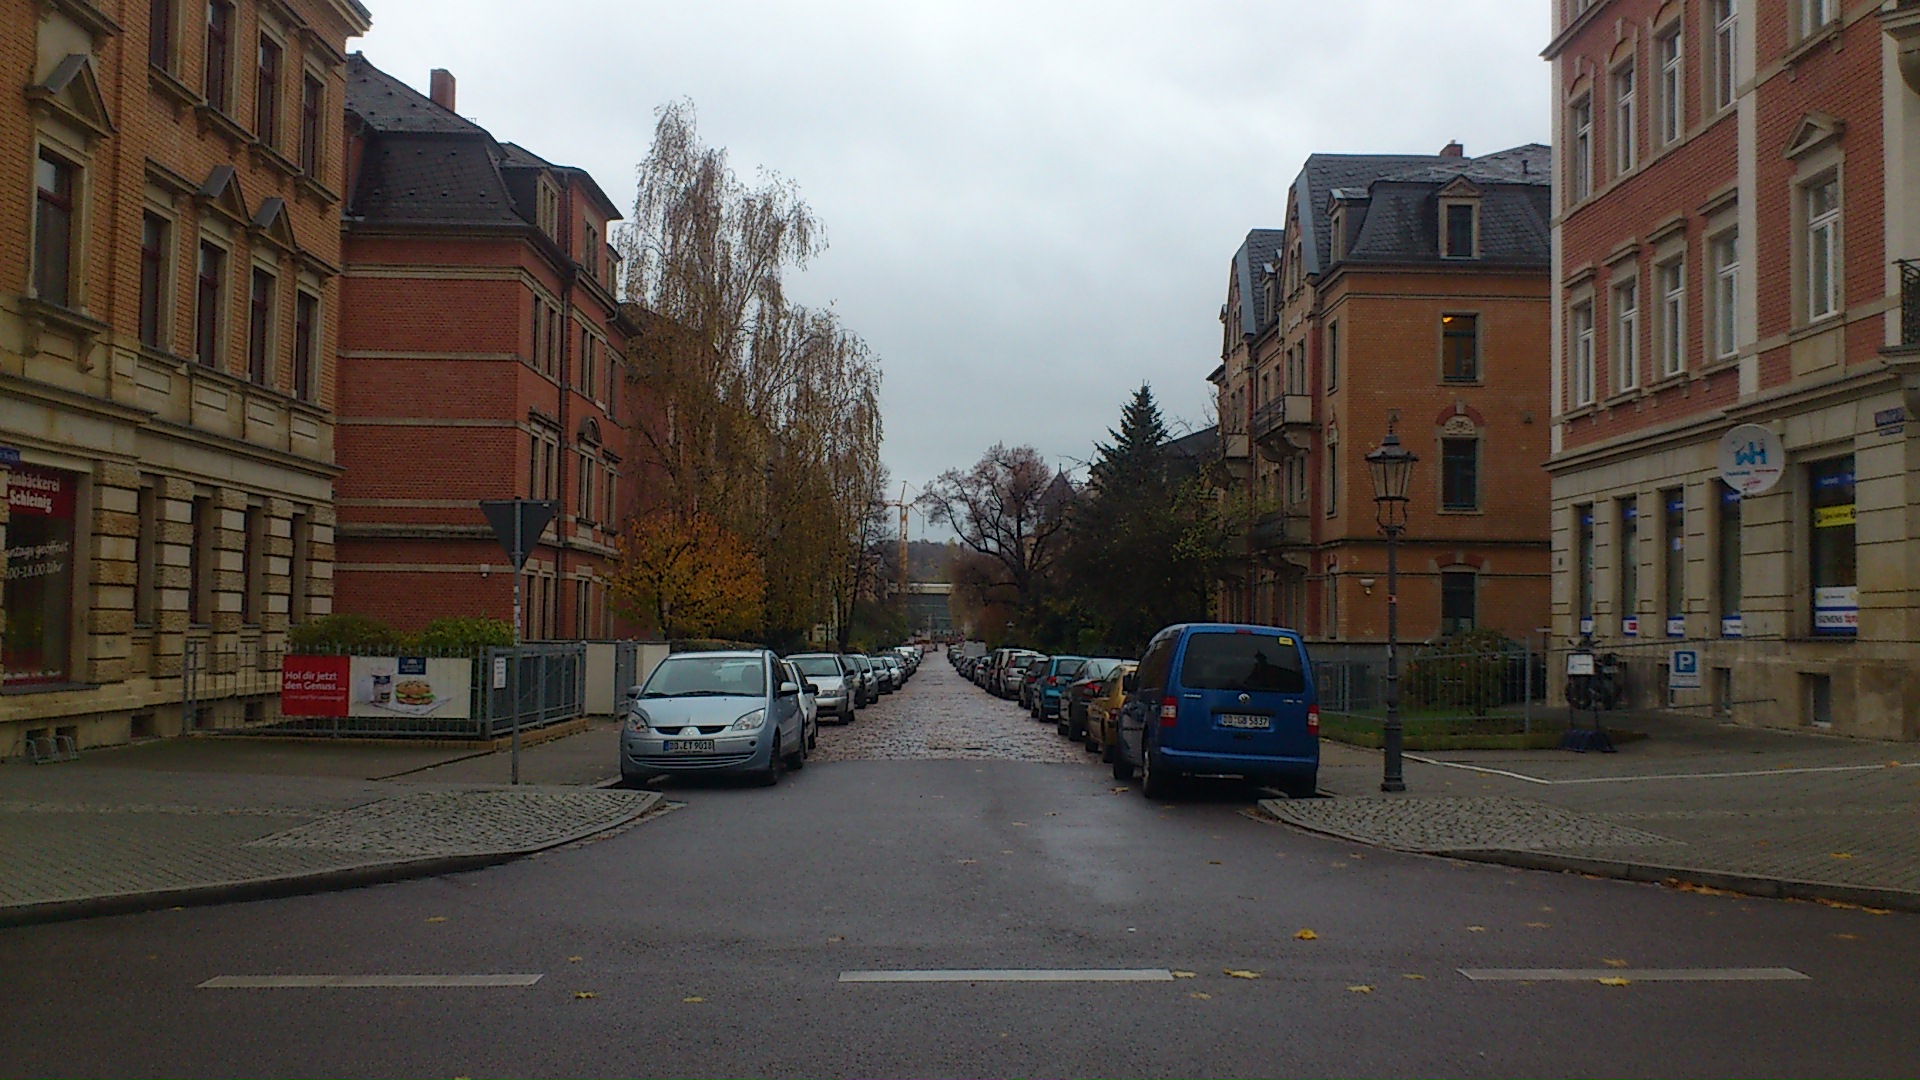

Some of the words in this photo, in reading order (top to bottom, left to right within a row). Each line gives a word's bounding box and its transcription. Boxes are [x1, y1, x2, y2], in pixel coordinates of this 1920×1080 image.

[7, 471, 61, 494] einbäckerei
[9, 489, 53, 514] Schleinig
[1678, 653, 1695, 671] P
[284, 671, 302, 681] Hol
[302, 671, 316, 681] dir
[315, 671, 338, 683] jetzt
[284, 680, 302, 690] den
[303, 681, 337, 691] Genuss
